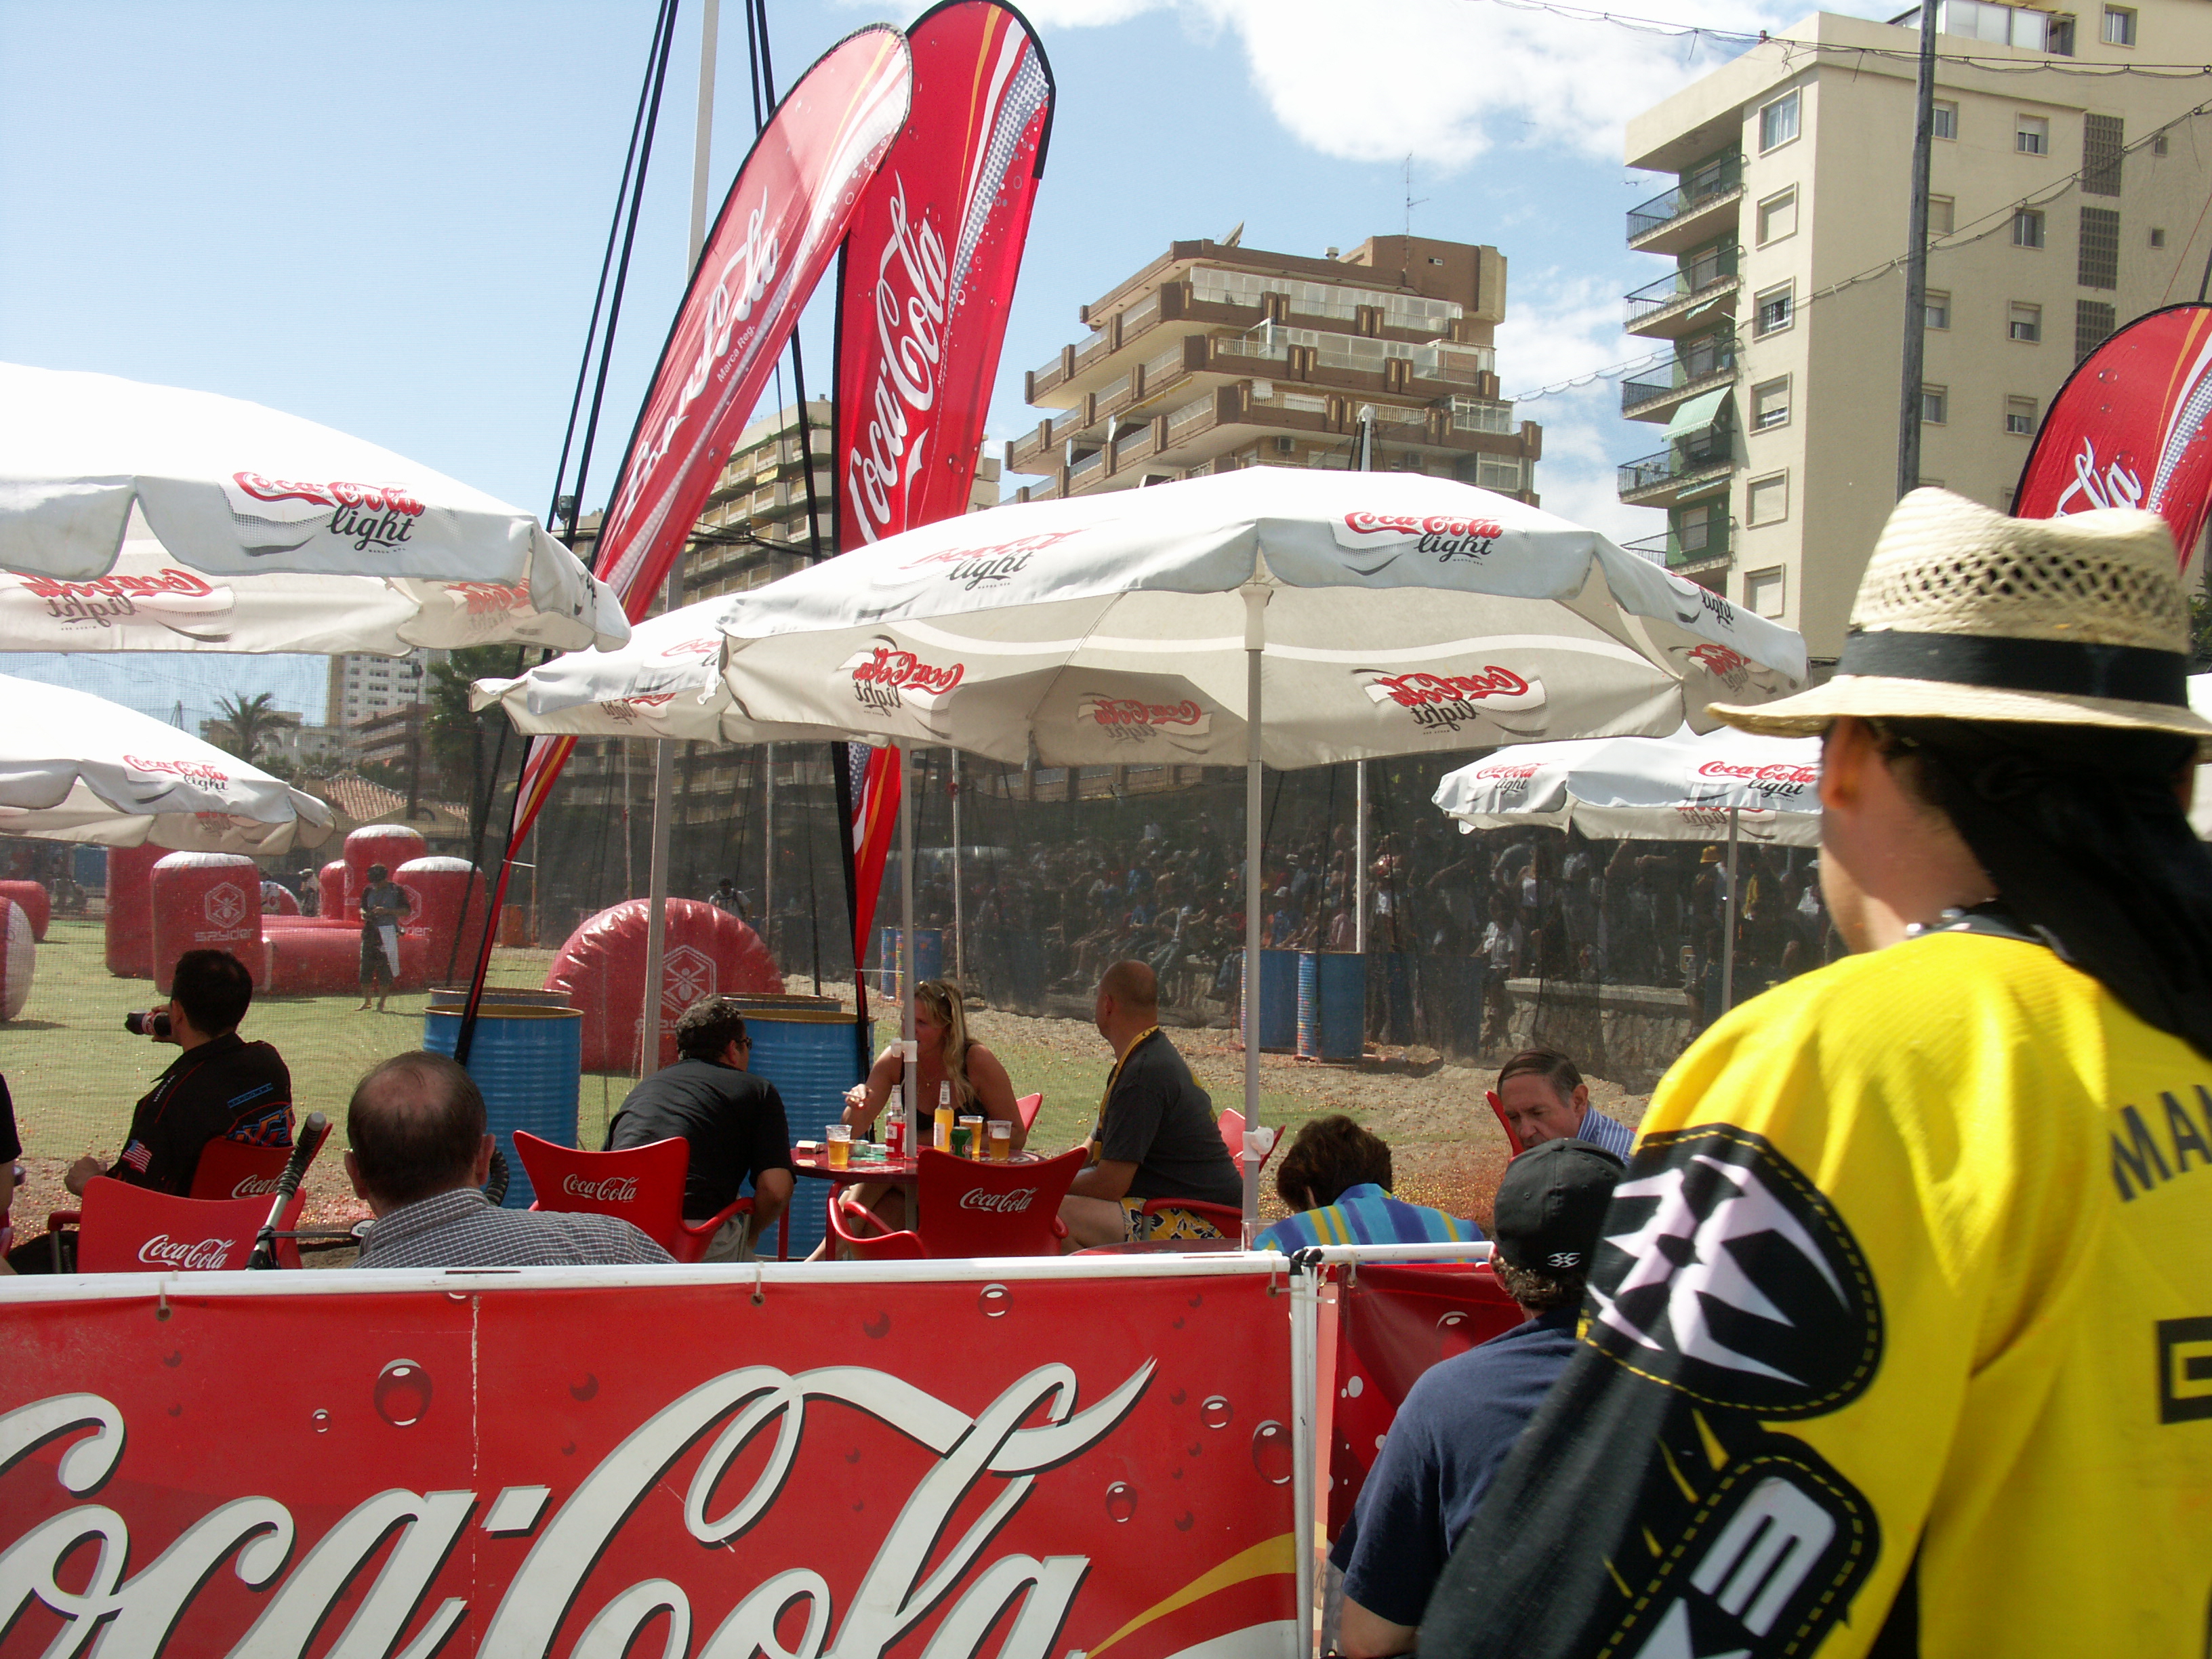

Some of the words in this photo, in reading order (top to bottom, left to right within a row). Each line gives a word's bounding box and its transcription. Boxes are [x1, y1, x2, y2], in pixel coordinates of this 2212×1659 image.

[717, 348, 740, 383] Marca
[737, 326, 756, 349] Reg.
[848, 169, 947, 544] Coca-Cola
[233, 472, 426, 517] Coca-Cola
[326, 503, 415, 551] light
[1345, 512, 1503, 539] Coca-Cola
[1413, 532, 1494, 562] light
[945, 550, 1035, 591] light
[123, 755, 229, 781] Coca-Cola
[1698, 761, 1820, 783] Coca-Cola
[184, 774, 229, 792] light
[1495, 777, 1528, 795] light
[1744, 779, 1805, 798] light
[563, 1174, 640, 1201] Coca-Cola
[960, 1187, 1039, 1212] Coca-Cola
[138, 1234, 237, 1269] Coca-Cola
[0, 1356, 1158, 1659] oca-Cola
